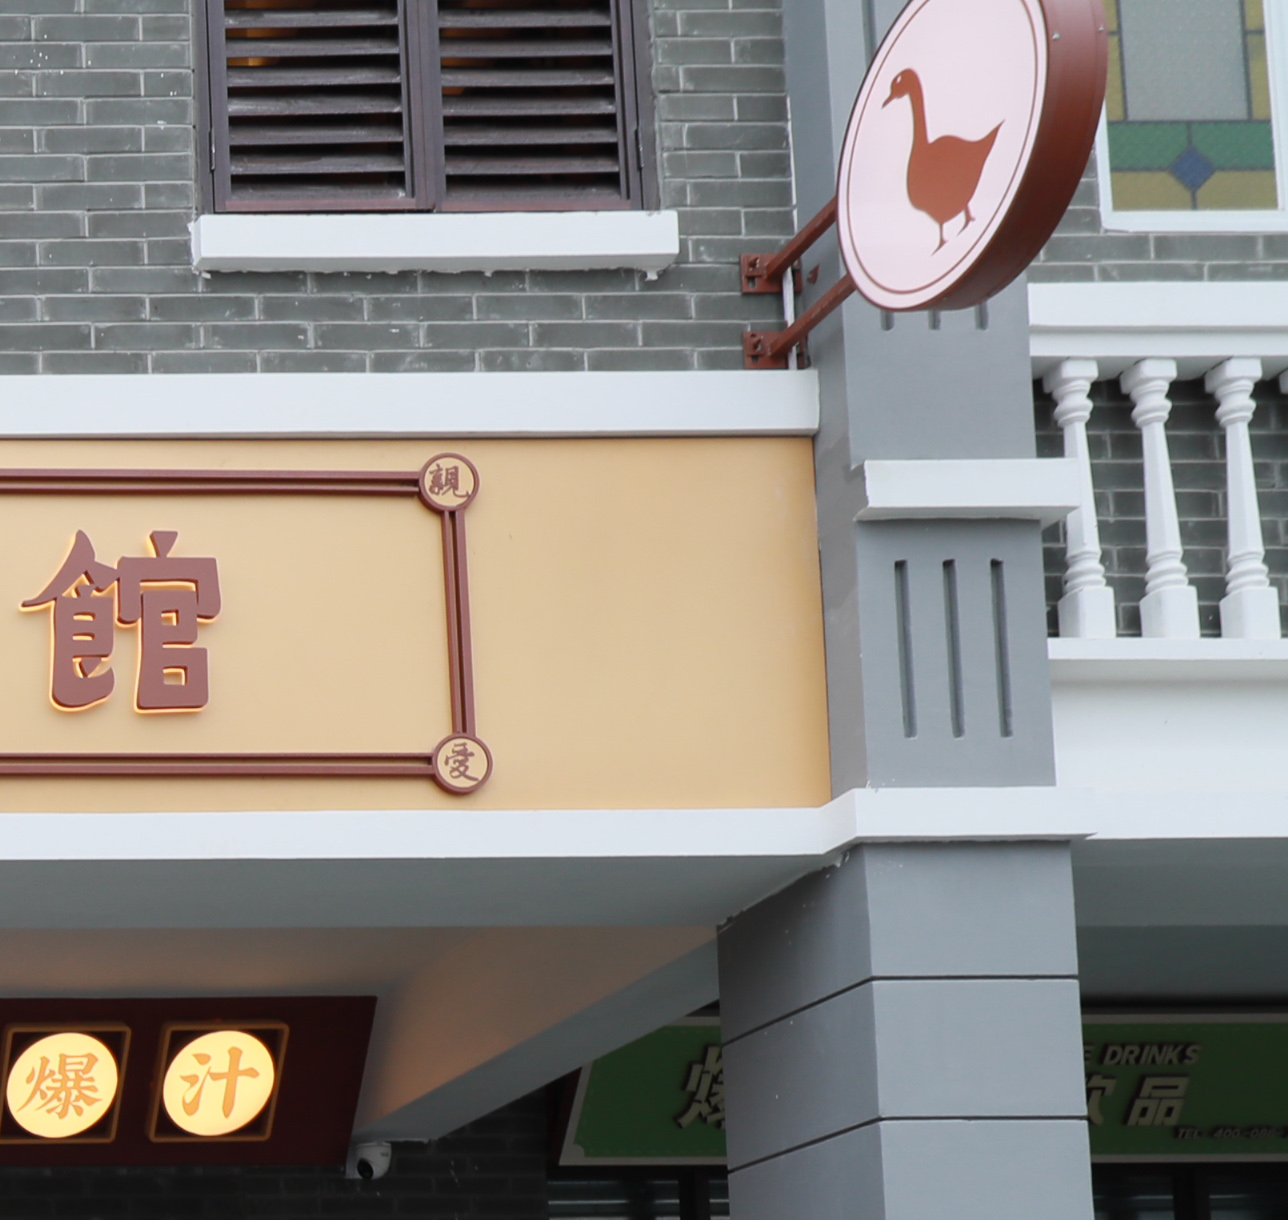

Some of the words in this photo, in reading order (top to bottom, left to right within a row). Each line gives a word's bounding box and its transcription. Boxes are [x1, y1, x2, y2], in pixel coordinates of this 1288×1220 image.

[428, 463, 471, 499] 親
[444, 741, 480, 784] 愛
[1104, 1043, 1203, 1065] DRINKS
